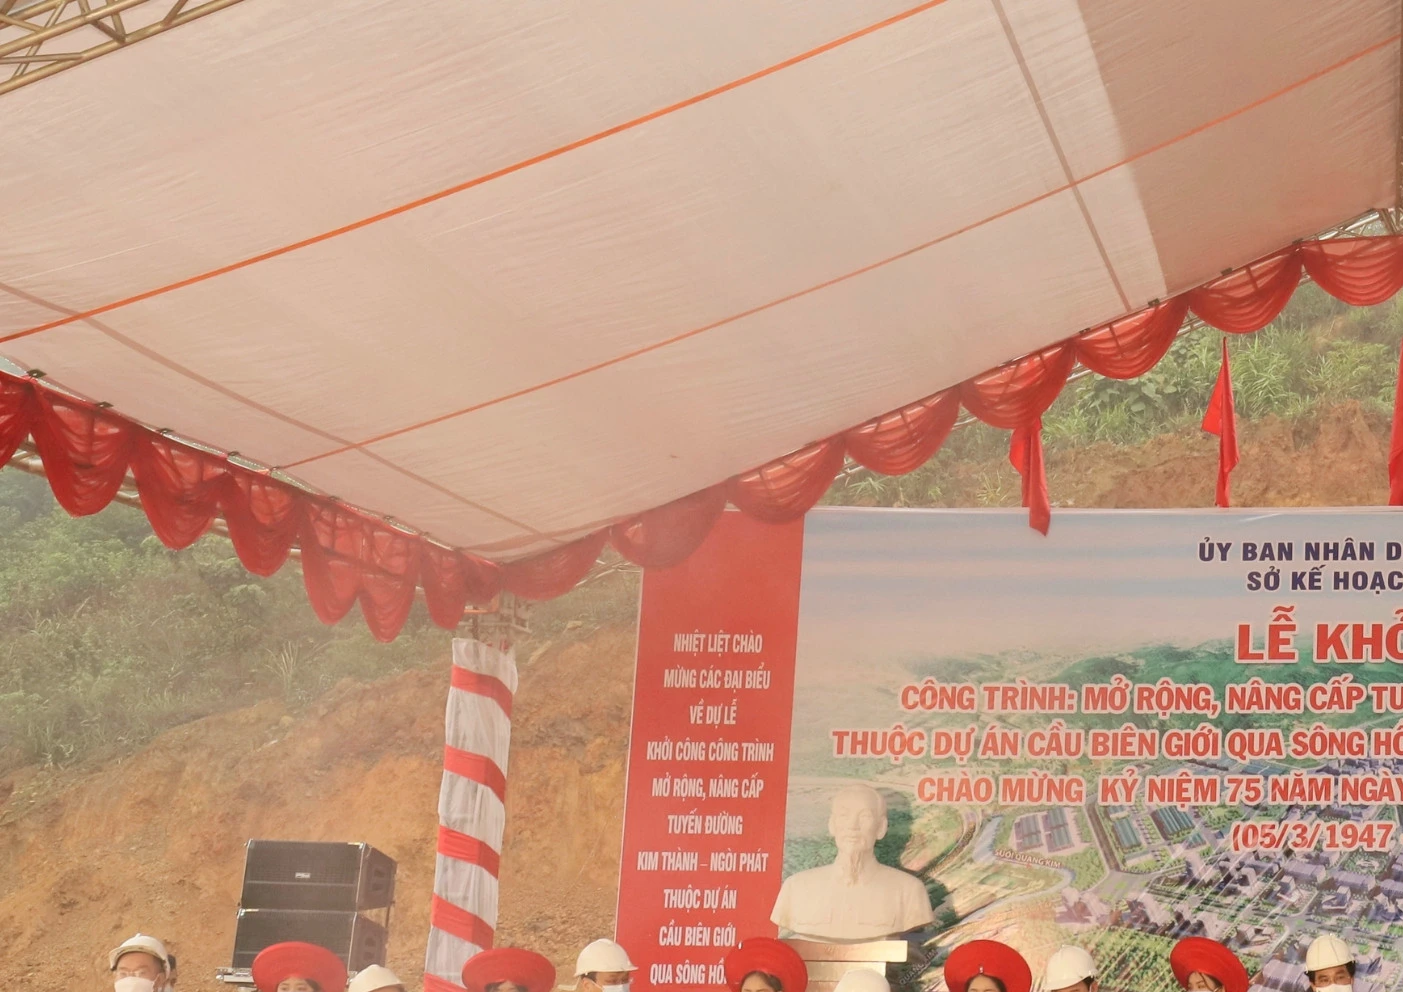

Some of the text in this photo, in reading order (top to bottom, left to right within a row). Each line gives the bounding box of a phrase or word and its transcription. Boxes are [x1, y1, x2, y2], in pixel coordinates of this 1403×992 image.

[1198, 537, 1232, 562] ỦY
[1242, 542, 1294, 562] BAN
[1304, 536, 1372, 562] NHÂN
[1246, 566, 1281, 592] SỞ
[1291, 564, 1328, 592] KẾ
[673, 629, 763, 657] NHIỆT LIỆT CHÀO
[1237, 605, 1297, 660] LỄ
[663, 662, 771, 693] MỪNG CÁC ĐẠI BIỂU
[901, 679, 975, 711] CÔNG
[983, 679, 1075, 711] TRÌNH:
[1083, 677, 1130, 711] MỞ
[1137, 679, 1218, 716] RỘNG,
[1227, 679, 1302, 711] NÂNG
[1309, 677, 1363, 711] CẤP
[689, 698, 737, 729] VỀ DỰ LỄ
[646, 735, 774, 762] KHỞI CÔNG CÔNG TRÌNH
[831, 727, 925, 762] THUỘC
[933, 727, 975, 762] DỰ
[980, 724, 1019, 757] ÁN
[1027, 723, 1082, 757] CẦU
[1092, 724, 1155, 757] BIÊN
[1164, 723, 1219, 757] GIỚI
[1227, 730, 1283, 761] QUA
[1292, 724, 1365, 756] SÔNG
[652, 771, 764, 802] MỞ RỘNG, NÂNG CẤP
[917, 771, 993, 803] CHÀO
[1001, 772, 1084, 803] MỪNG
[1100, 767, 1138, 803] KỶ
[1147, 771, 1218, 807] NIỆM
[1226, 777, 1261, 803] 75
[1270, 771, 1335, 803] NĂM
[667, 808, 743, 835] TUYẾN ĐƯỜNG
[637, 851, 659, 871] KIM
[661, 847, 698, 872] THÀNH
[709, 848, 737, 872] NGÒI
[738, 848, 769, 872] PHÁT
[1045, 859, 1061, 869] KIM
[663, 884, 737, 914] THUỘC DỰ ÁN
[658, 919, 736, 947] CẦU BIÊN GIỚI
[650, 963, 673, 986] QUA
[675, 959, 707, 985] SÔNG
